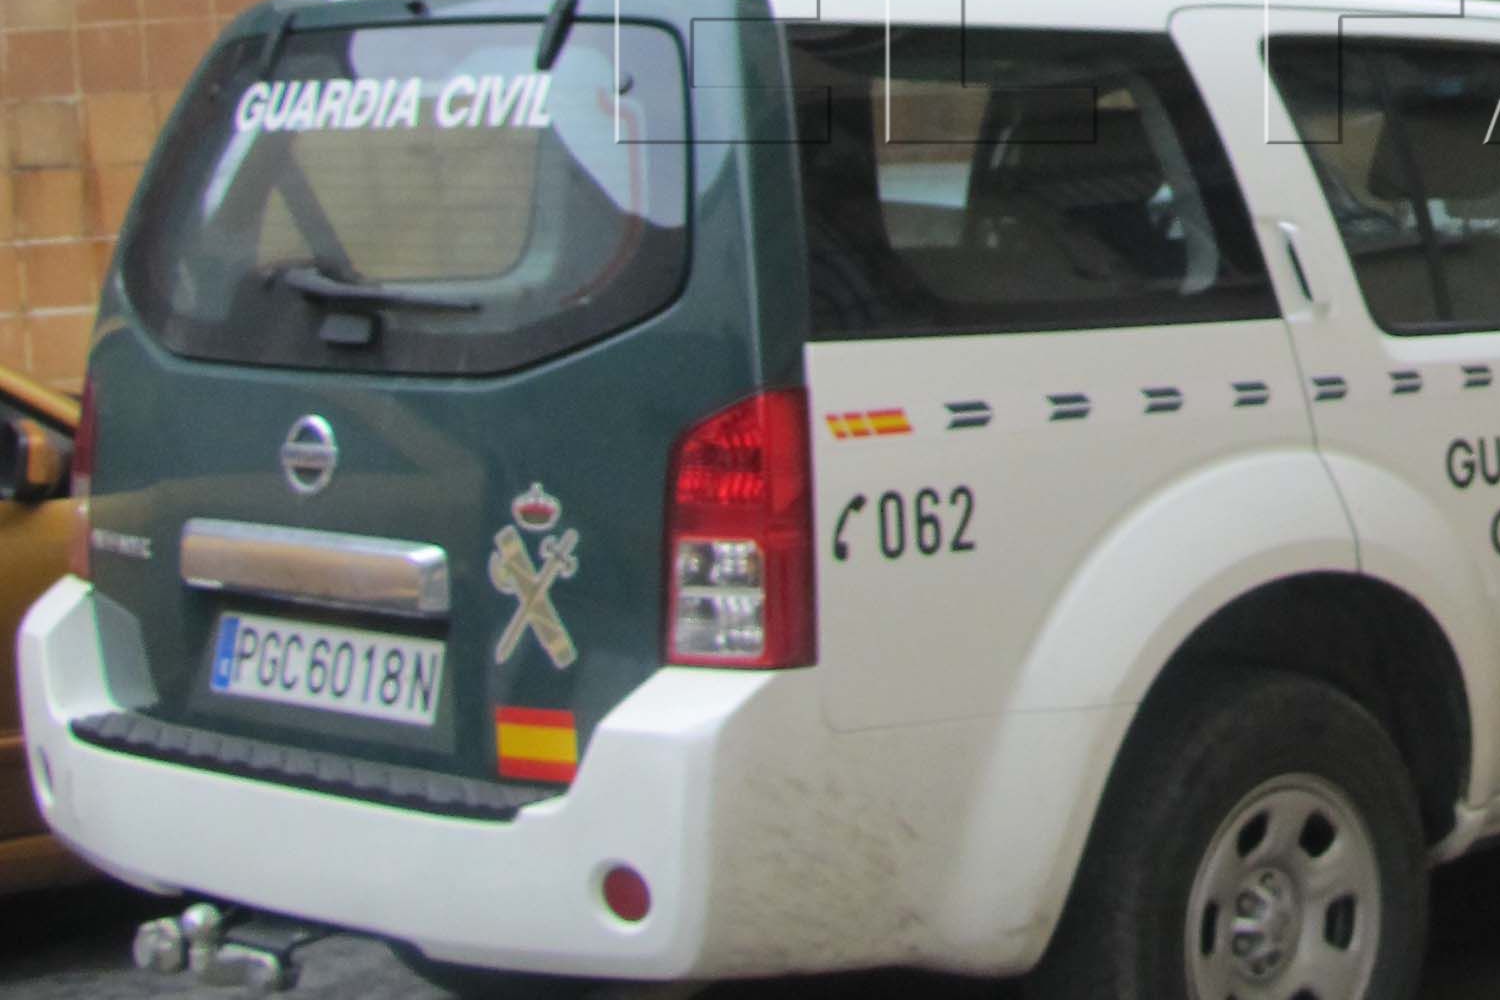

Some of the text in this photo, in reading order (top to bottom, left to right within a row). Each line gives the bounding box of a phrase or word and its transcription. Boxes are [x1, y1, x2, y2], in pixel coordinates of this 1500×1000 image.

[235, 72, 553, 131] GUARDIA CIVIL
[879, 484, 975, 559] 062
